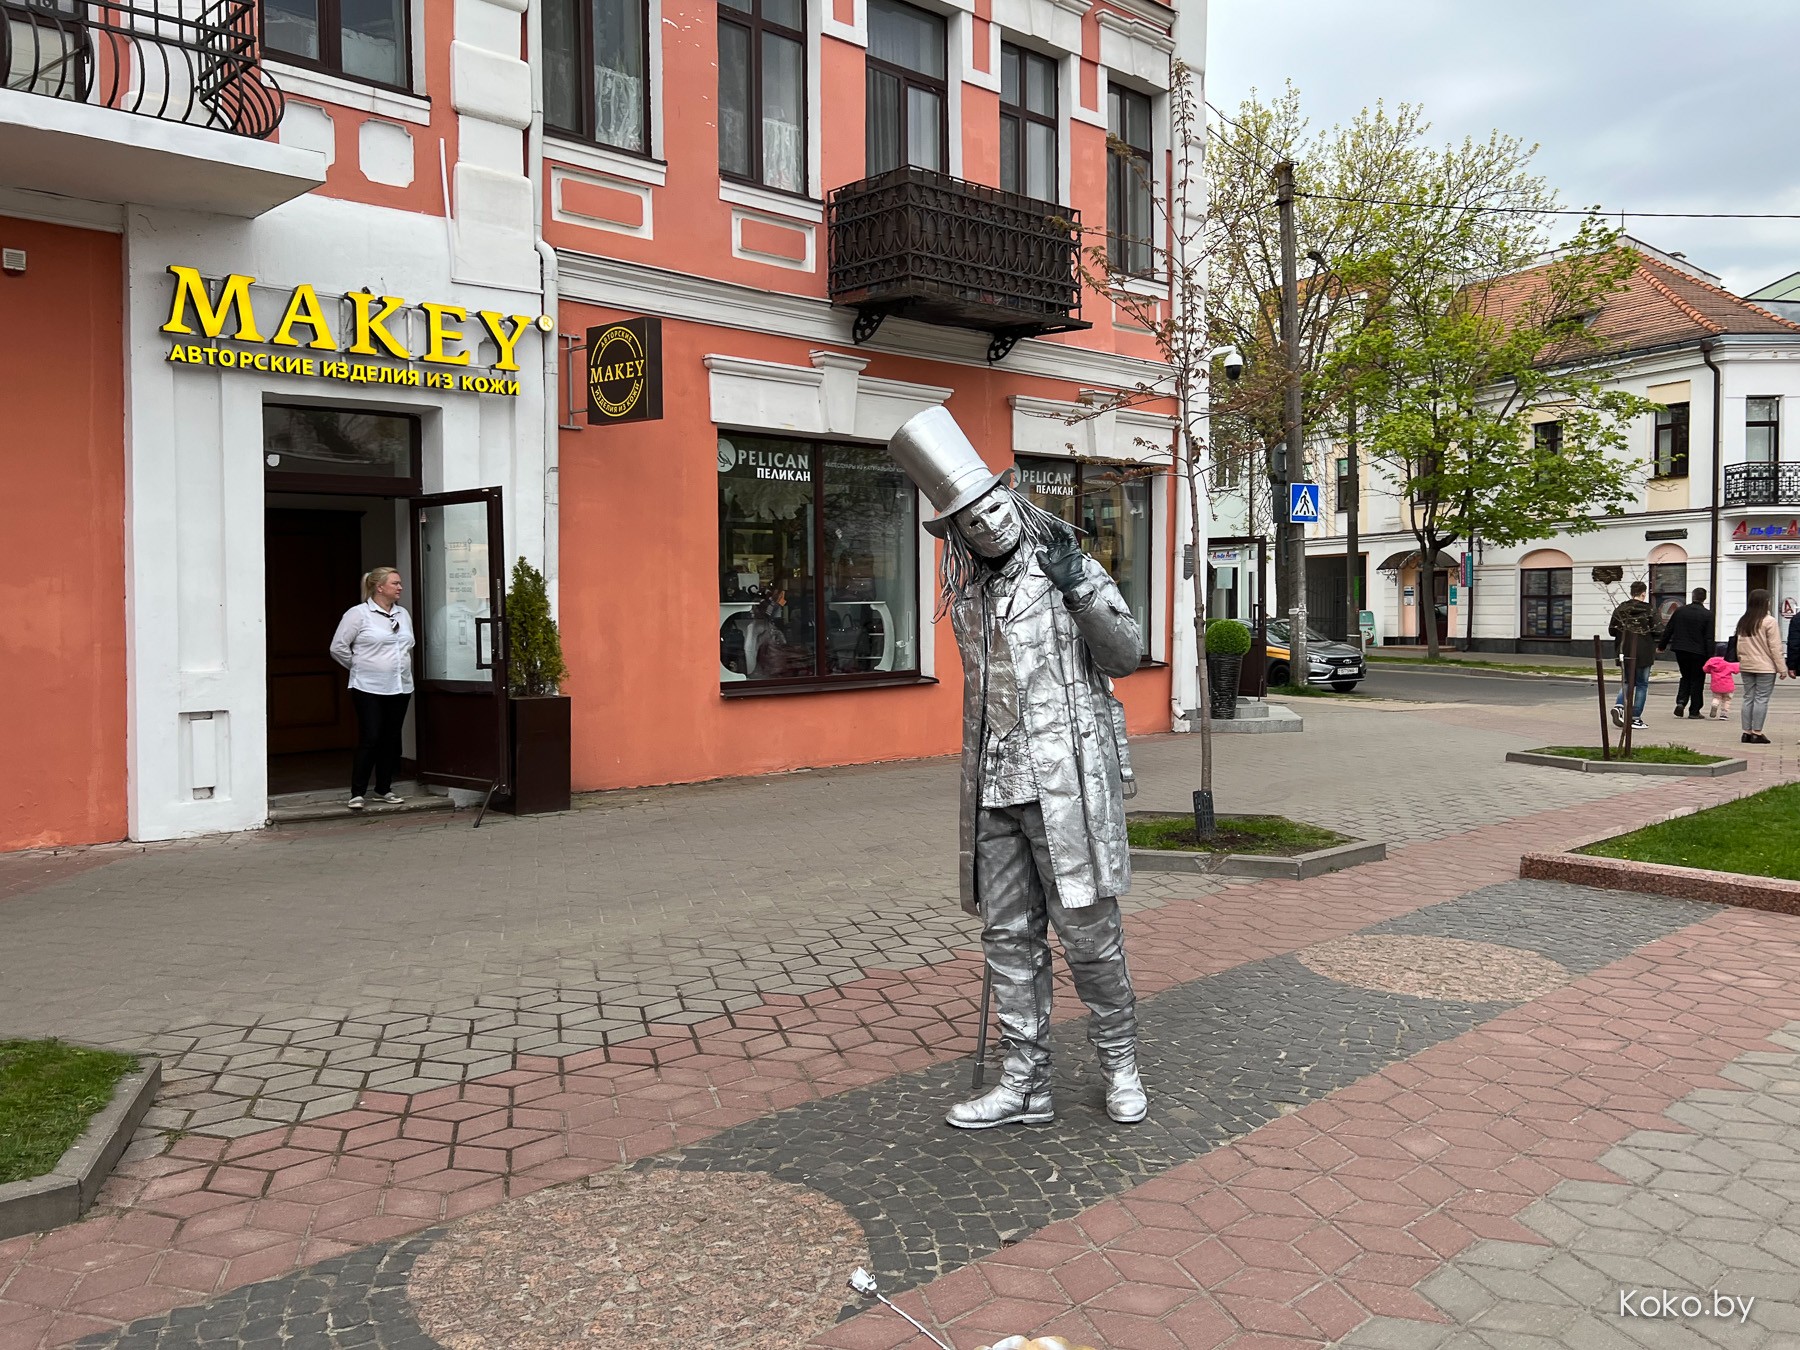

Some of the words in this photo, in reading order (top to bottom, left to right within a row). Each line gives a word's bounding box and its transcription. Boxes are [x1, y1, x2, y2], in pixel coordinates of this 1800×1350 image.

[161, 265, 531, 371] MAKEY
[601, 330, 633, 348] АВТОРСКИЕ
[169, 344, 315, 376] АВТОРСКИЕ
[322, 360, 420, 386] ИЗДЕЛИЯ
[425, 371, 454, 389] ИЗ
[462, 376, 520, 396] КОЖИ
[589, 359, 645, 384] MAKEY
[594, 389, 618, 413] ИЗДЕЛИЯ
[618, 404, 627, 413] ИЗ
[626, 382, 640, 407] КОЖИ
[738, 449, 809, 470] PELICAN
[756, 467, 811, 482] ПЕЛИКАН
[1022, 469, 1072, 486] PELICAN
[1036, 484, 1074, 496] ПЕЛИКАН
